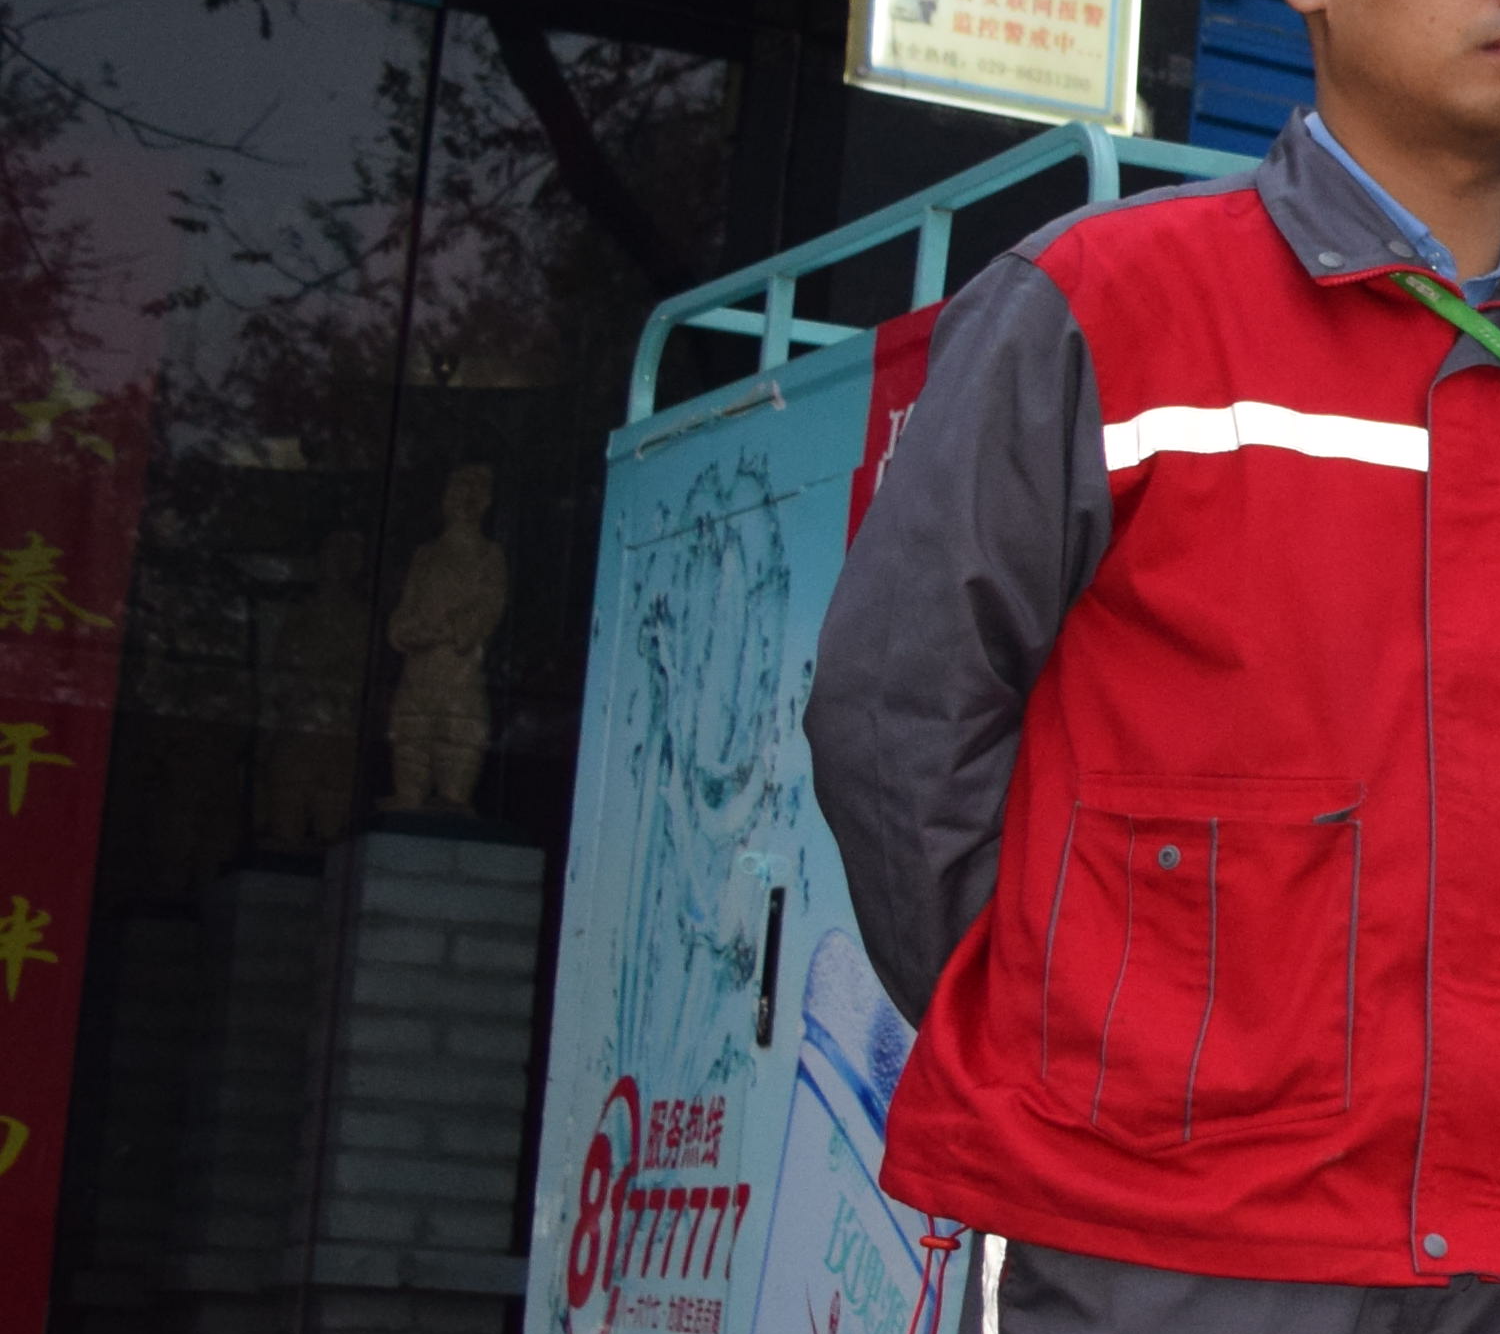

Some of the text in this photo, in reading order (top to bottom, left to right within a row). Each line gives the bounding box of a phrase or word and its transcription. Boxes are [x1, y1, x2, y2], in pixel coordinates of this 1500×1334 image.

[643, 1095, 726, 1171] 服务热线
[567, 1132, 752, 1310] 81777777
